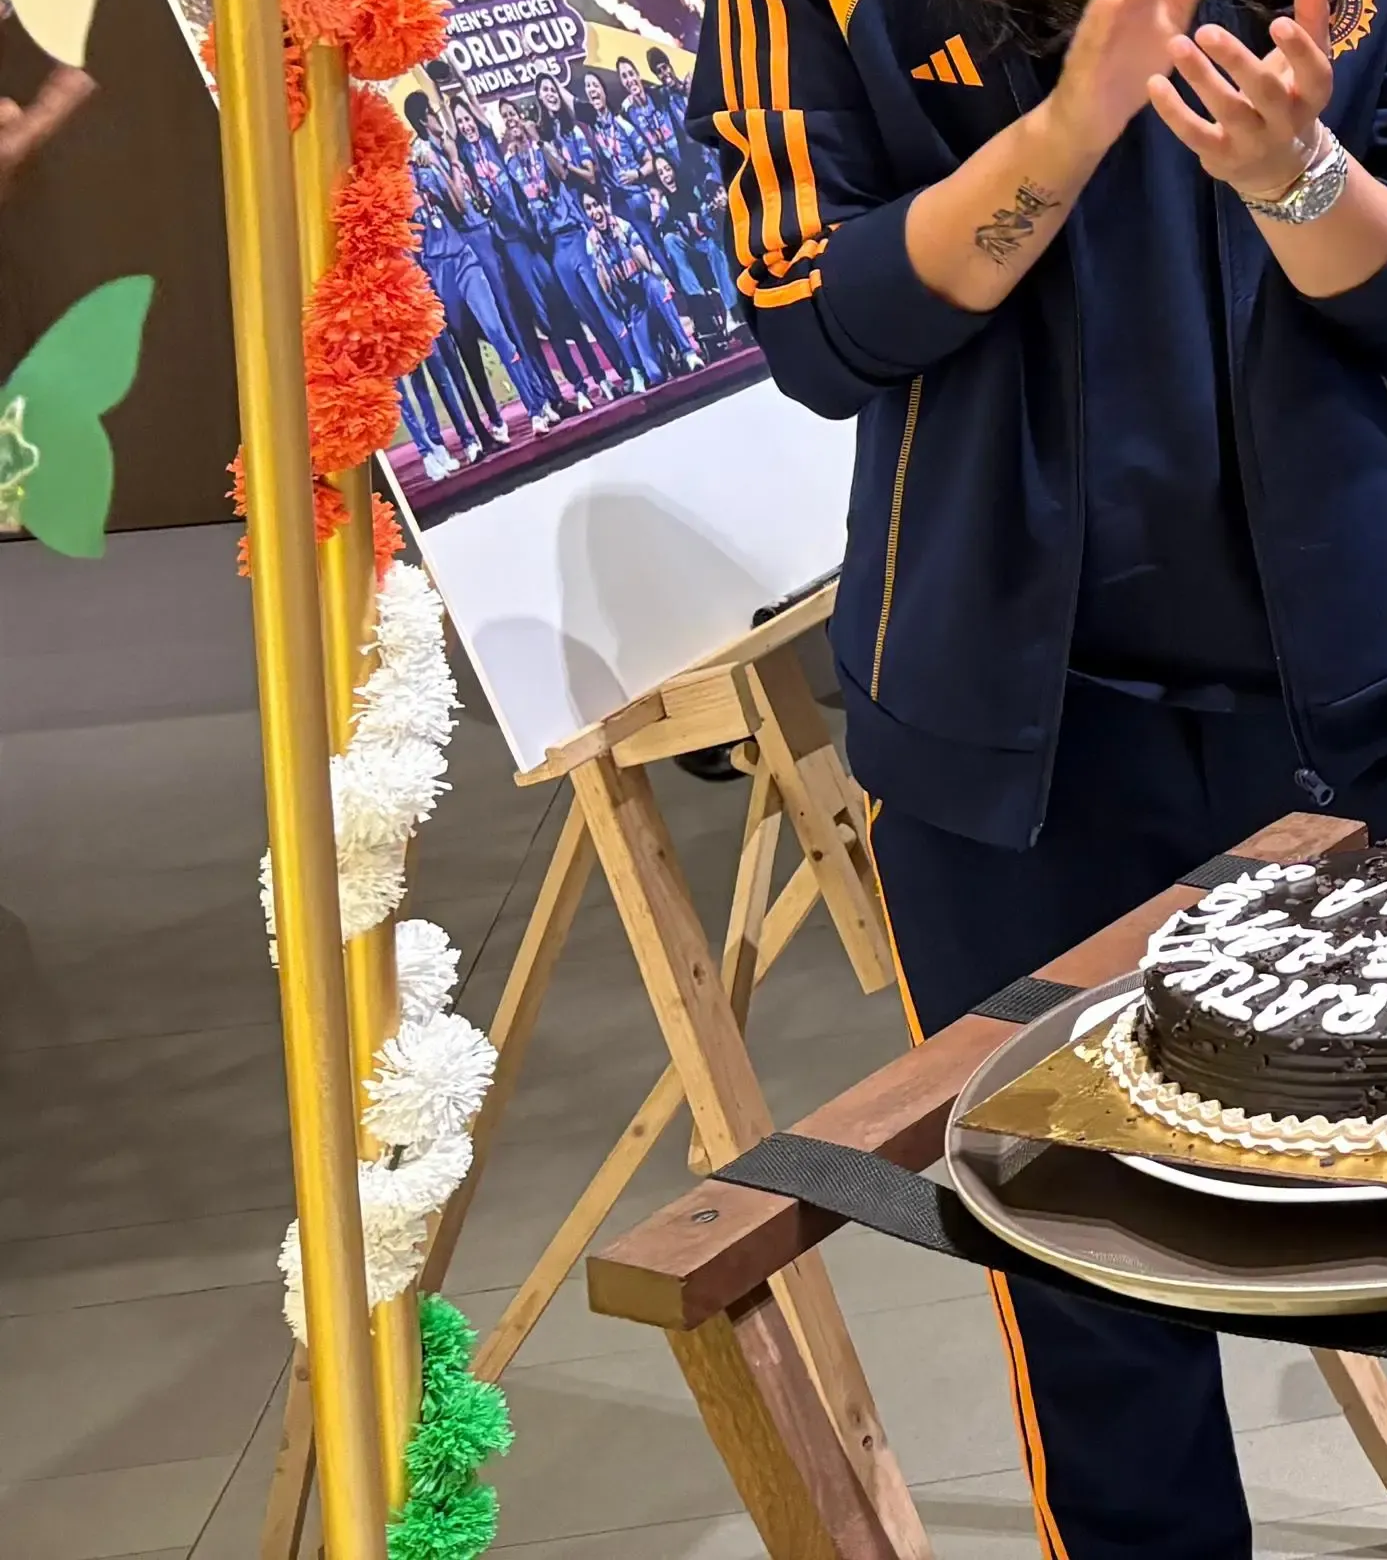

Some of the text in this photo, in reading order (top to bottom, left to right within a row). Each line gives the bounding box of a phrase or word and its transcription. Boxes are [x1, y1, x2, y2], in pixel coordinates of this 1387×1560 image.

[446, 8, 494, 35] MEN'S
[524, 16, 577, 54] CUP
[466, 68, 519, 95] INDIA
